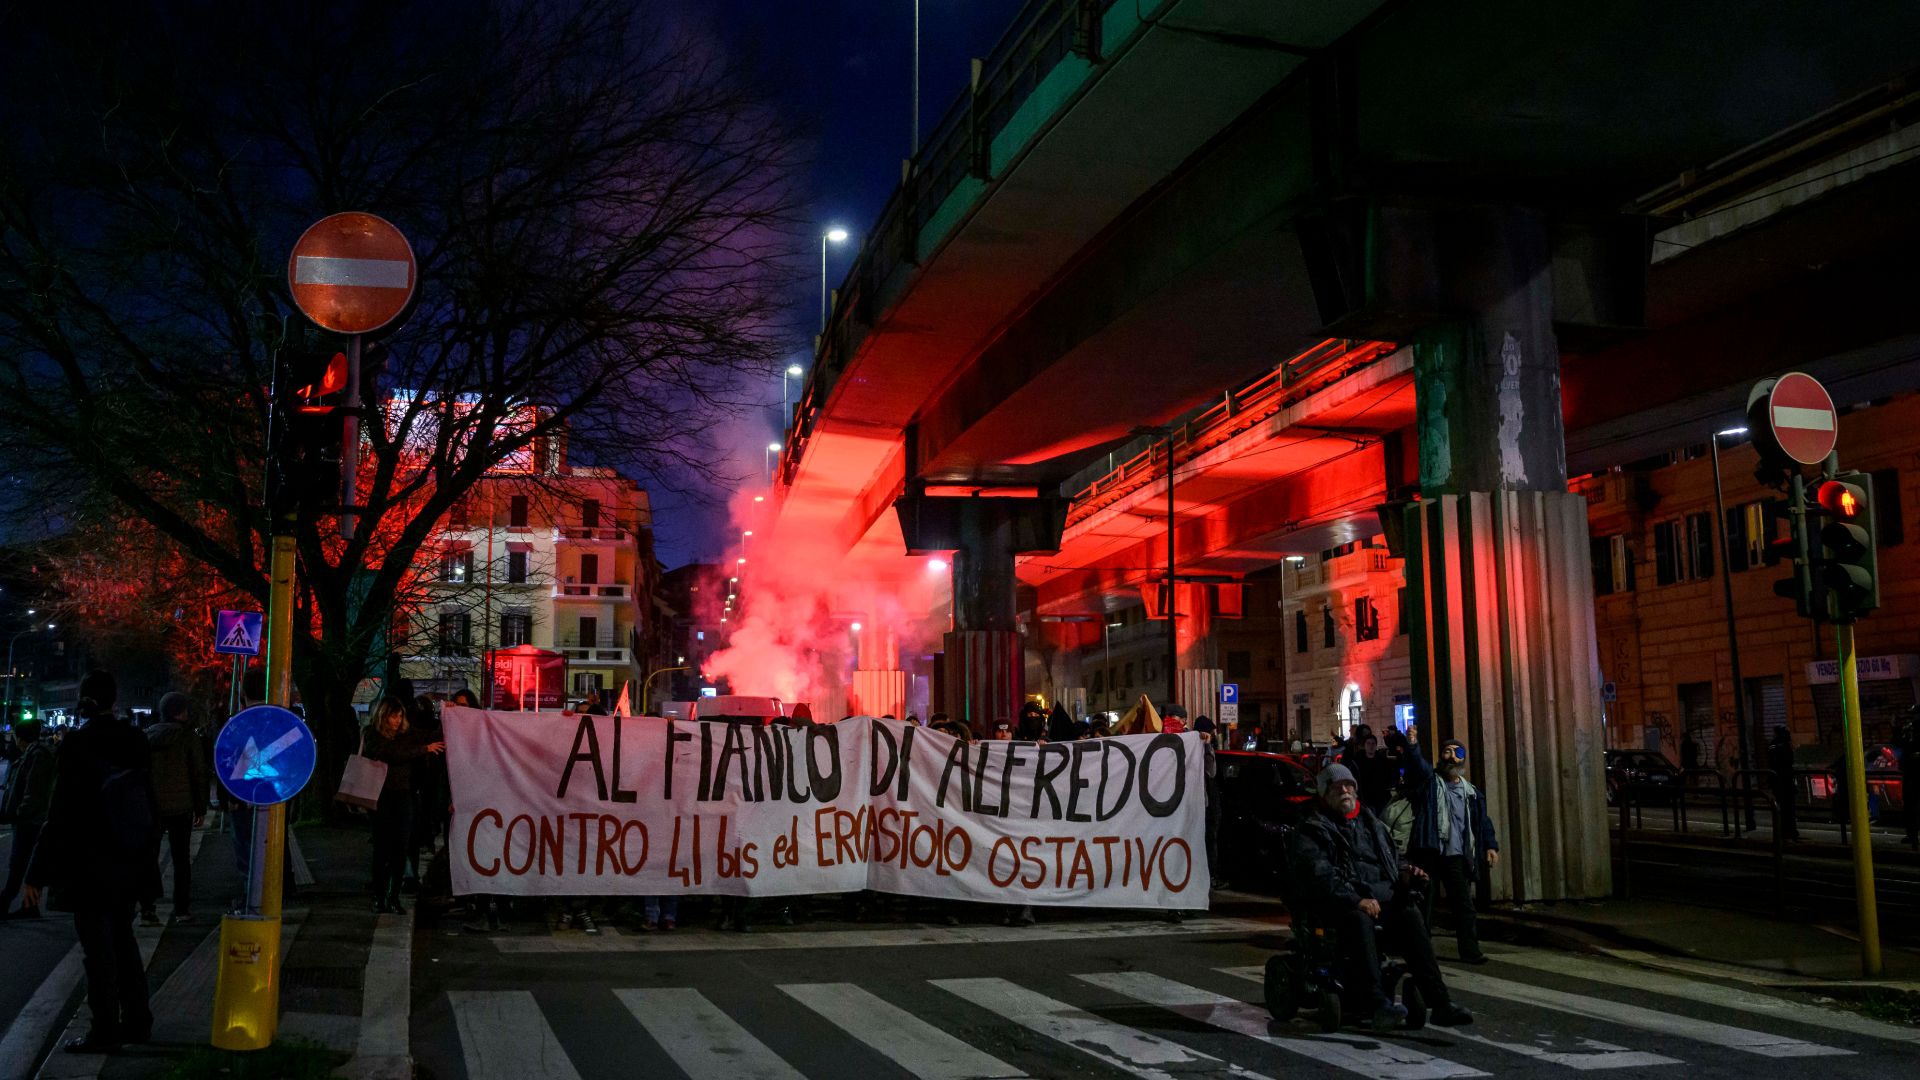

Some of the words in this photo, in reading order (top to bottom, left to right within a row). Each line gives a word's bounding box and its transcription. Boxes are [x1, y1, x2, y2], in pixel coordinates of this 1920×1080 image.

[1223, 685, 1235, 702] P
[1816, 661, 1840, 676] VENDES
[556, 715, 638, 803] AL
[663, 717, 842, 803] FIANCO
[869, 718, 915, 802] DI
[936, 733, 1186, 823] ALFREDO
[467, 807, 649, 877] CONTRO
[667, 815, 702, 888] 41
[716, 815, 759, 880] bis
[772, 815, 800, 870] ed
[987, 835, 1193, 894] OSTATIVO
